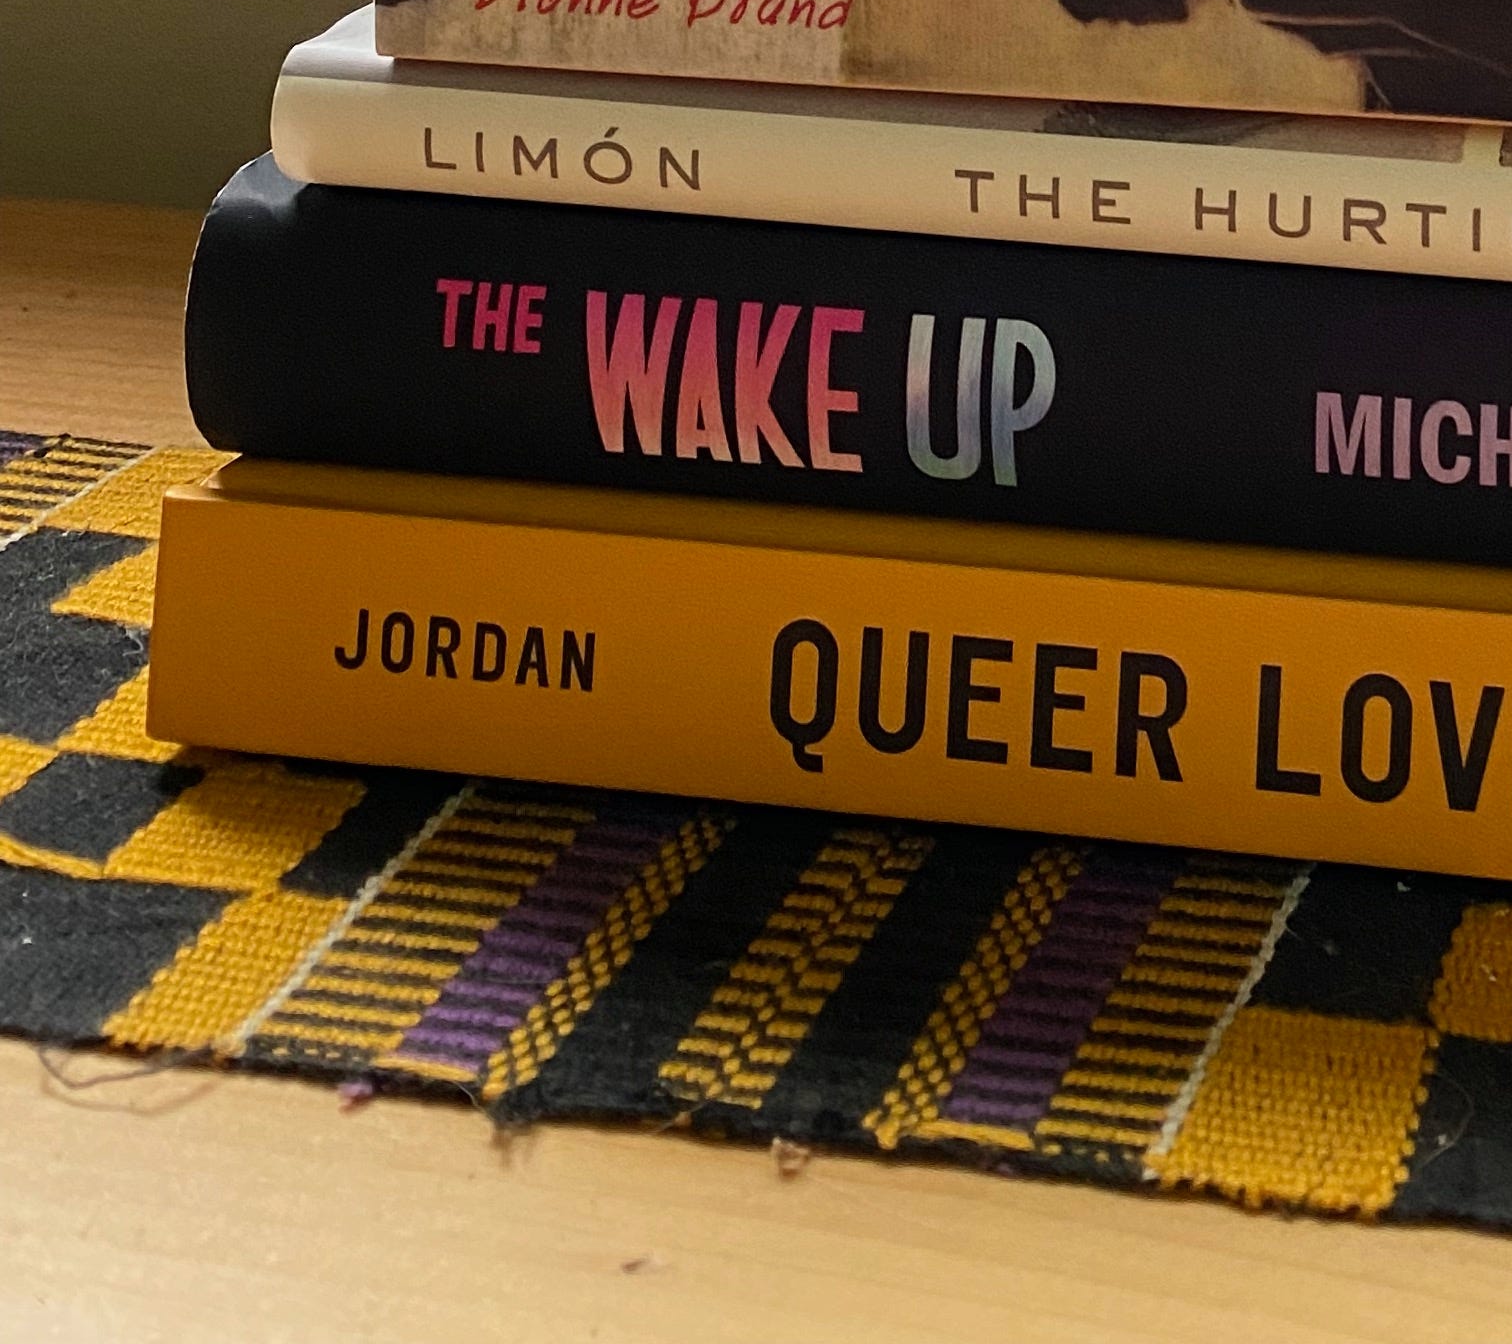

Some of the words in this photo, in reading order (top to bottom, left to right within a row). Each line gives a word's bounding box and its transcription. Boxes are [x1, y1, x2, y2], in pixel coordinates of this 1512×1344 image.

[424, 126, 700, 191] LIMÓN
[954, 168, 1132, 225] THE
[436, 278, 547, 354] THE
[586, 289, 866, 473] WAKE
[905, 313, 1057, 488] UP
[335, 608, 597, 693] JORDAN
[769, 618, 1189, 783] QUEER
